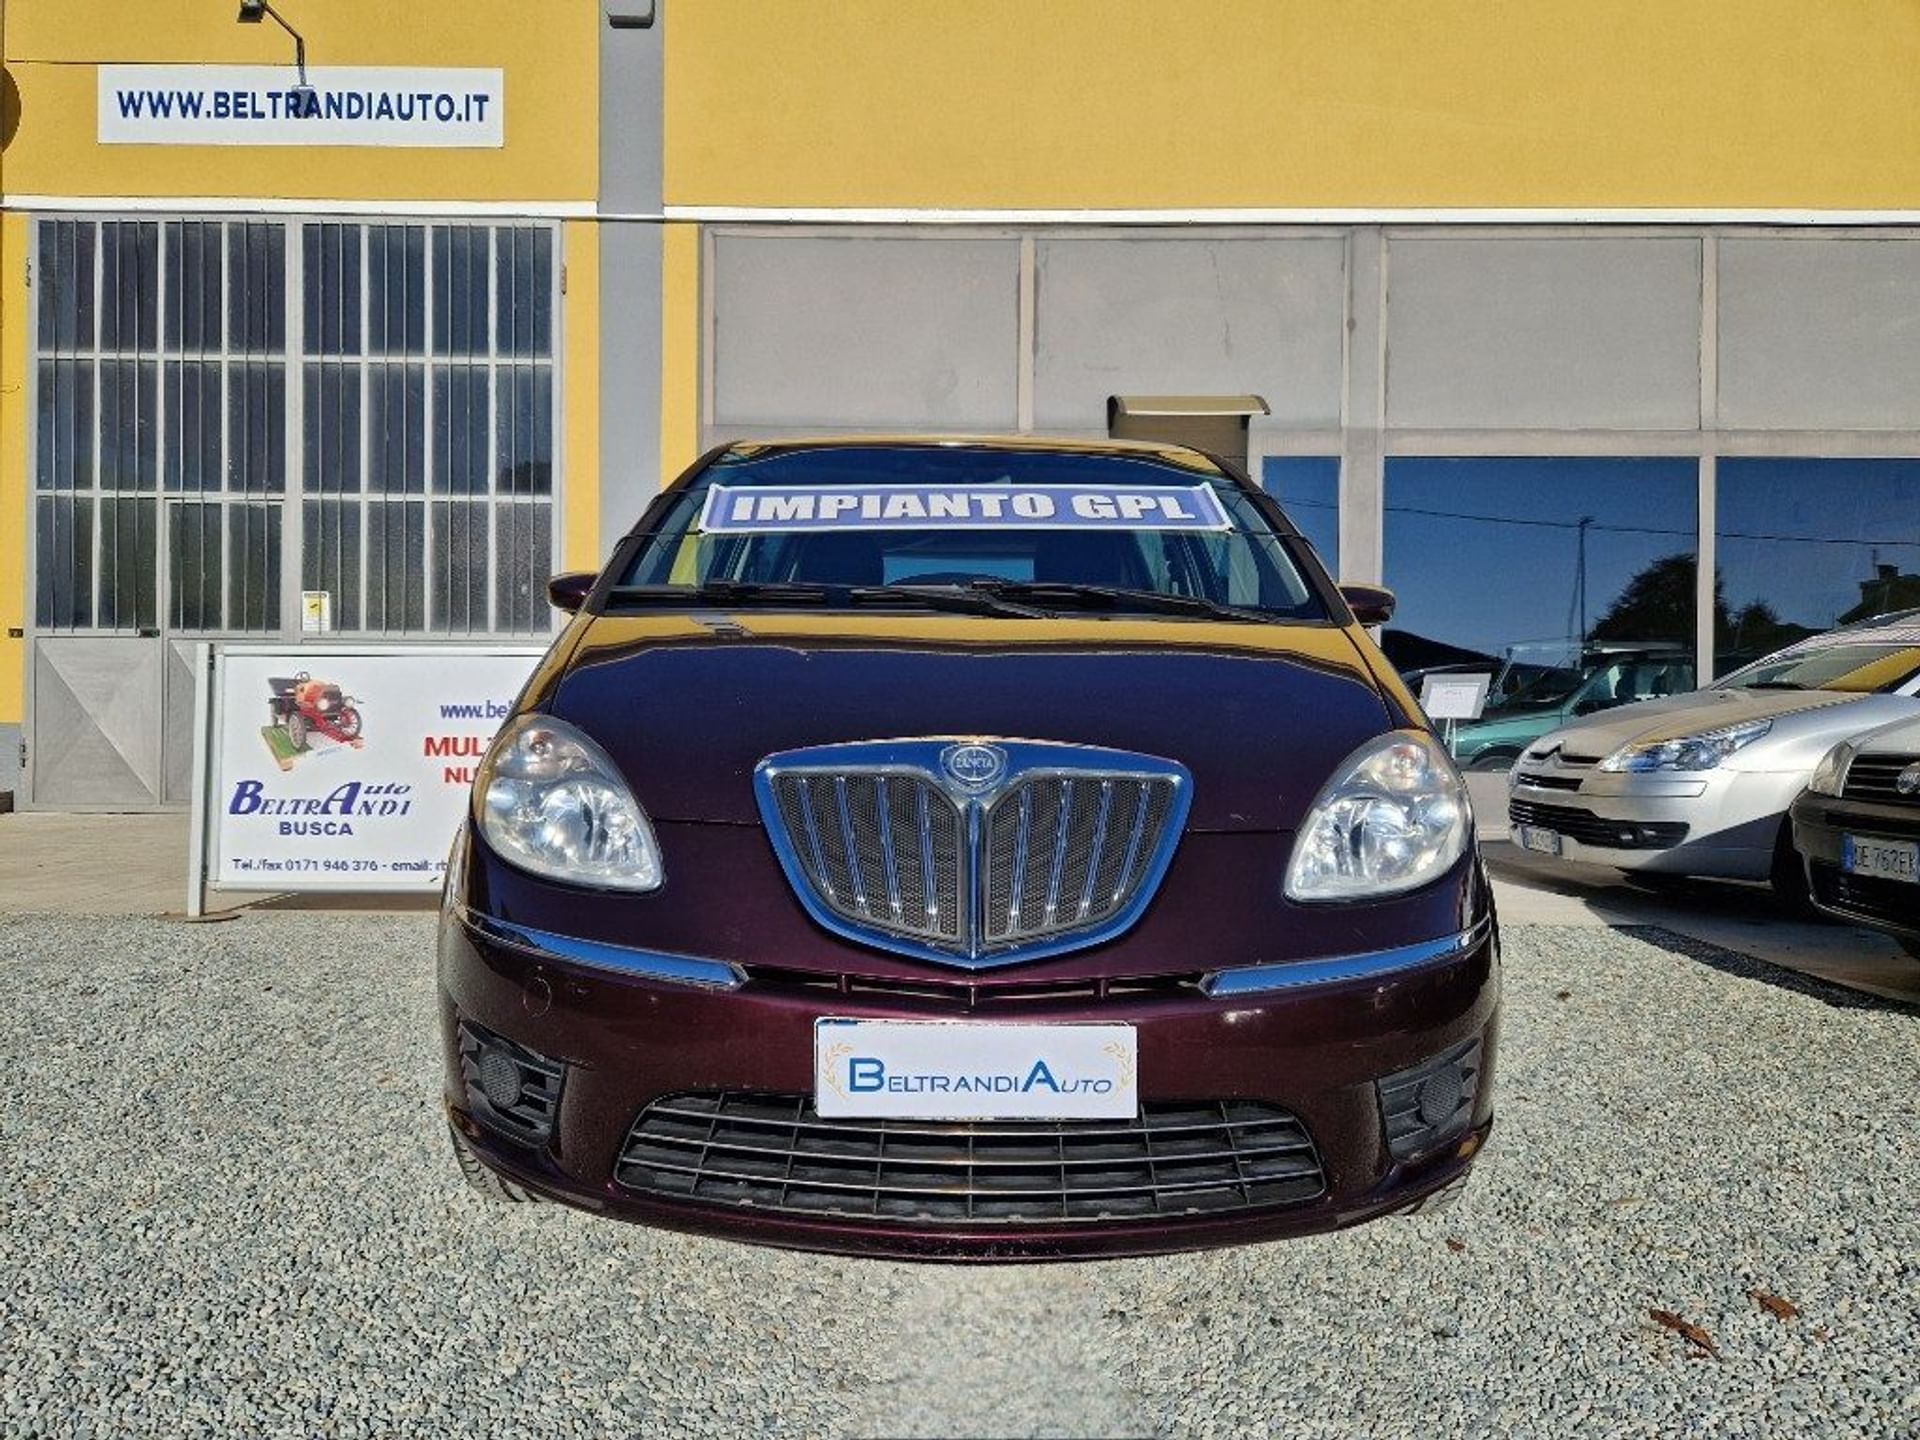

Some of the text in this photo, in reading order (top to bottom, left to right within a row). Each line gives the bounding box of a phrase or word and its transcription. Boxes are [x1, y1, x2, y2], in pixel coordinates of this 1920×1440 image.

[117, 90, 490, 122] WWW.BELTRANDIAUTO.IT
[730, 493, 1198, 522] IMPIANTO GPL
[279, 821, 354, 836] BUSCA
[284, 859, 319, 872] 0171
